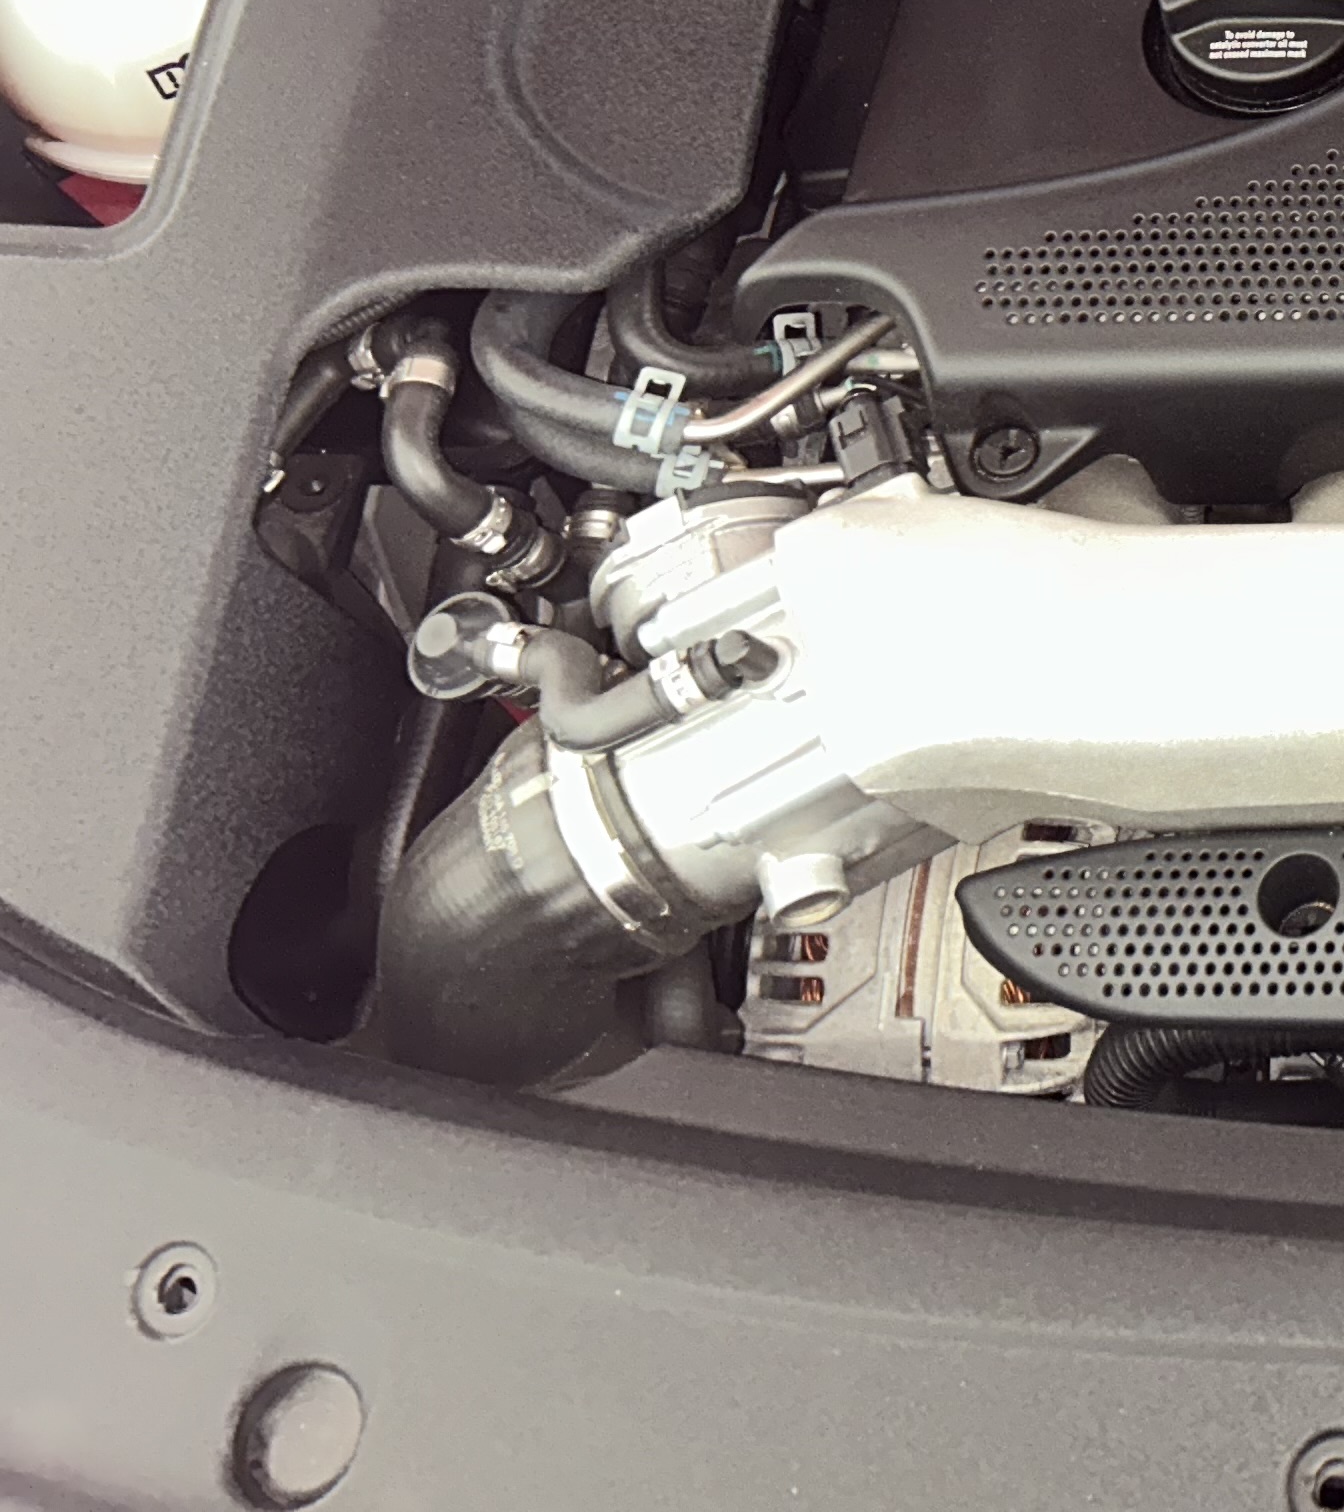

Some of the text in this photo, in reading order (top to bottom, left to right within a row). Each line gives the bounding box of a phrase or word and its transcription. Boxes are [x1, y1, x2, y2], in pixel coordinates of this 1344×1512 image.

[1224, 30, 1296, 41] To avoid damage to
[1209, 39, 1308, 50] catalytic converter oil must
[1208, 48, 1307, 60] not exceed maximum mark
